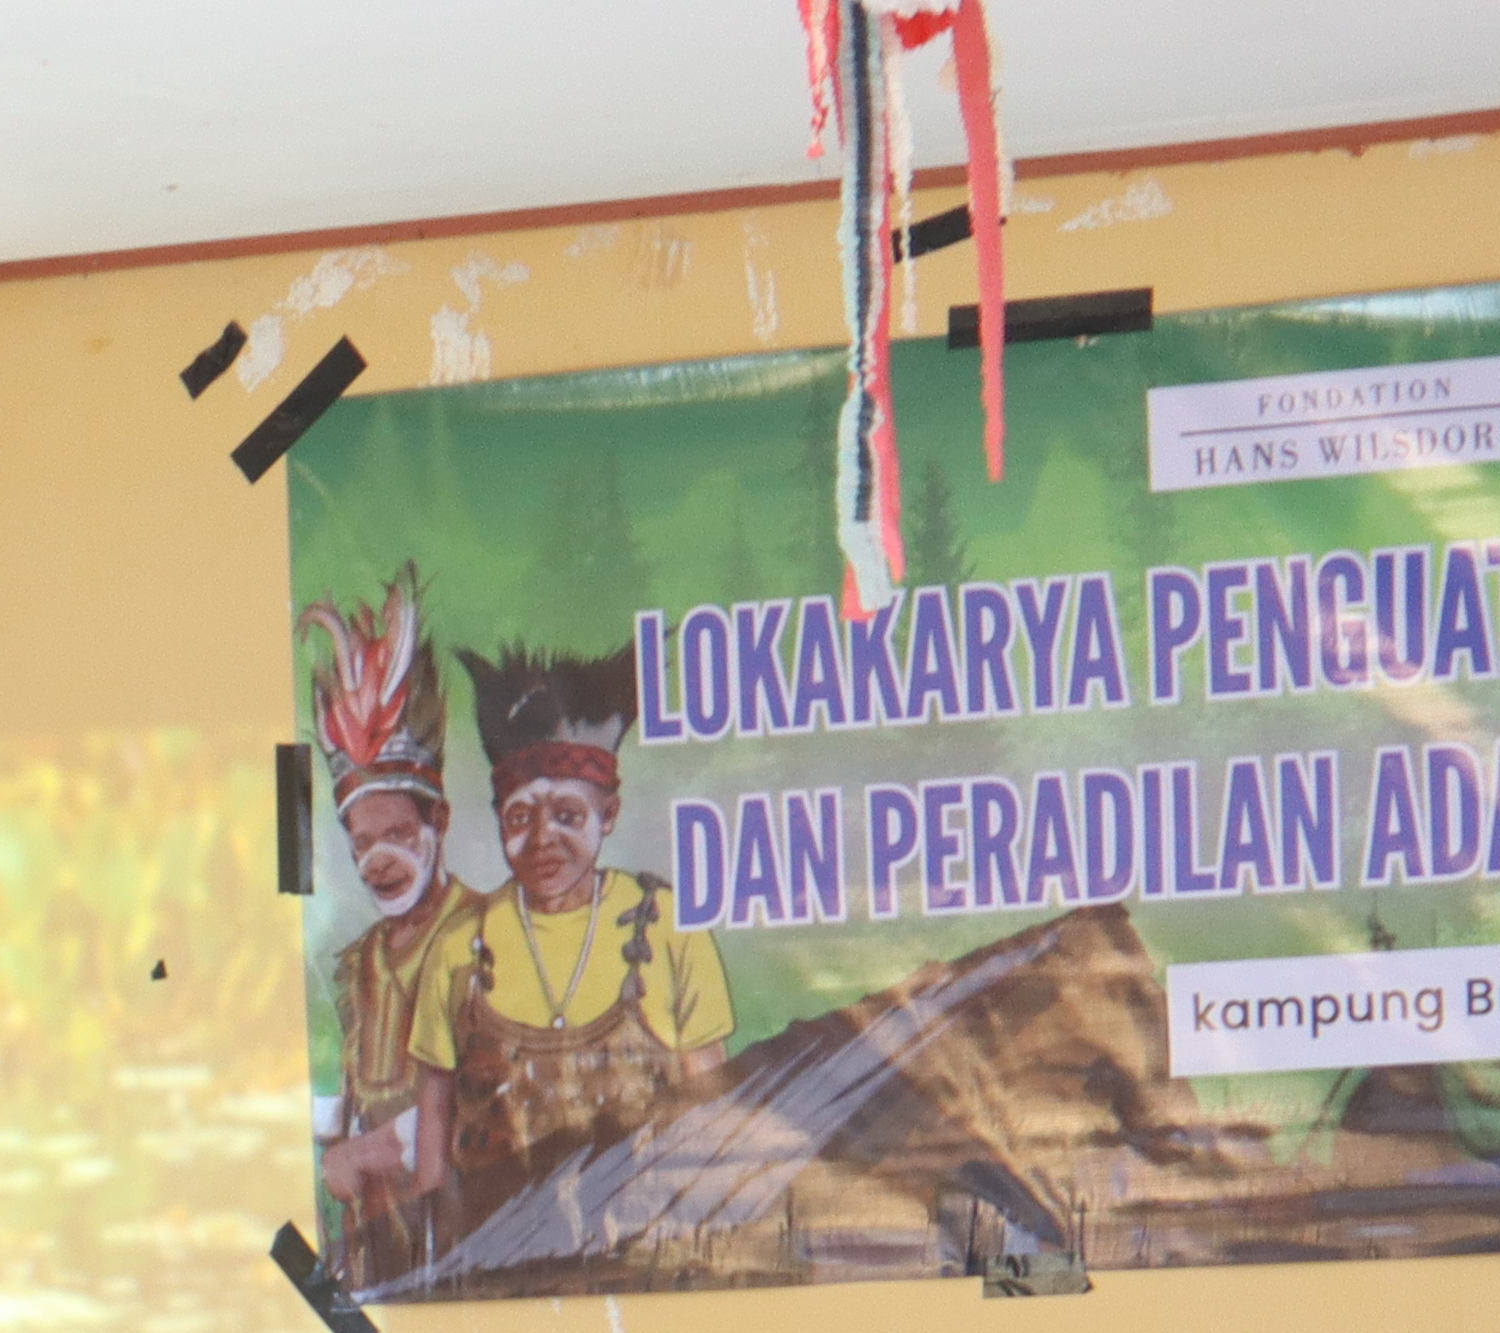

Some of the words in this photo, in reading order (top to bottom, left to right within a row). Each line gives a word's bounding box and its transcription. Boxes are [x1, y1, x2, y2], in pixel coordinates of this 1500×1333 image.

[1258, 376, 1453, 417] FONDATION
[1193, 438, 1299, 477] HANS
[636, 571, 1131, 745] LOKAKARYA
[671, 786, 846, 932] DAN
[864, 750, 1340, 918] PERADILAN
[1193, 985, 1446, 1039] kampung
